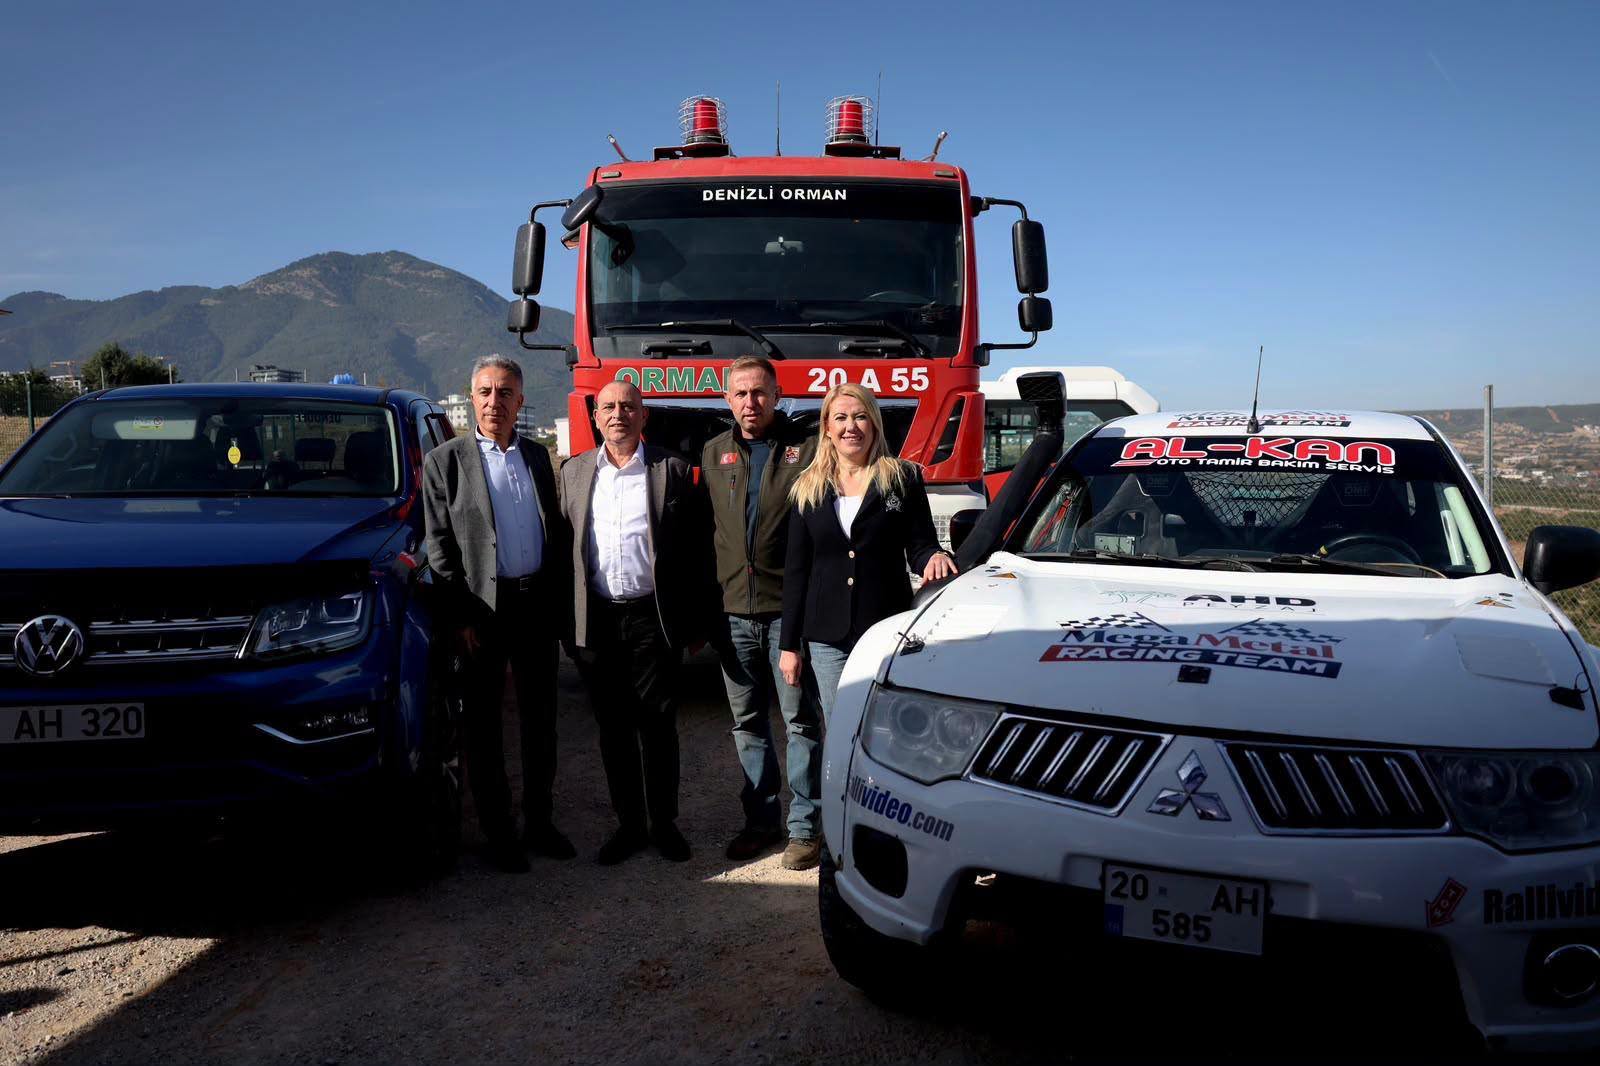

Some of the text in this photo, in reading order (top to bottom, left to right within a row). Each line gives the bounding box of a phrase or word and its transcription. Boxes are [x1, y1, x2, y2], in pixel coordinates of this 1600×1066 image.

[702, 185, 847, 201] DENİZLİ ORMAN
[807, 366, 930, 392] 20 A 55
[1120, 437, 1396, 466] AL-KAN
[1156, 458, 1191, 466] OTO
[1183, 594, 1317, 607] AHD
[1059, 629, 1334, 659] Mega Metal
[1055, 646, 1327, 674] RACING TEAM
[14, 705, 142, 740] AH 320
[1110, 871, 1260, 916] 20 AH
[1152, 908, 1212, 943] 585
